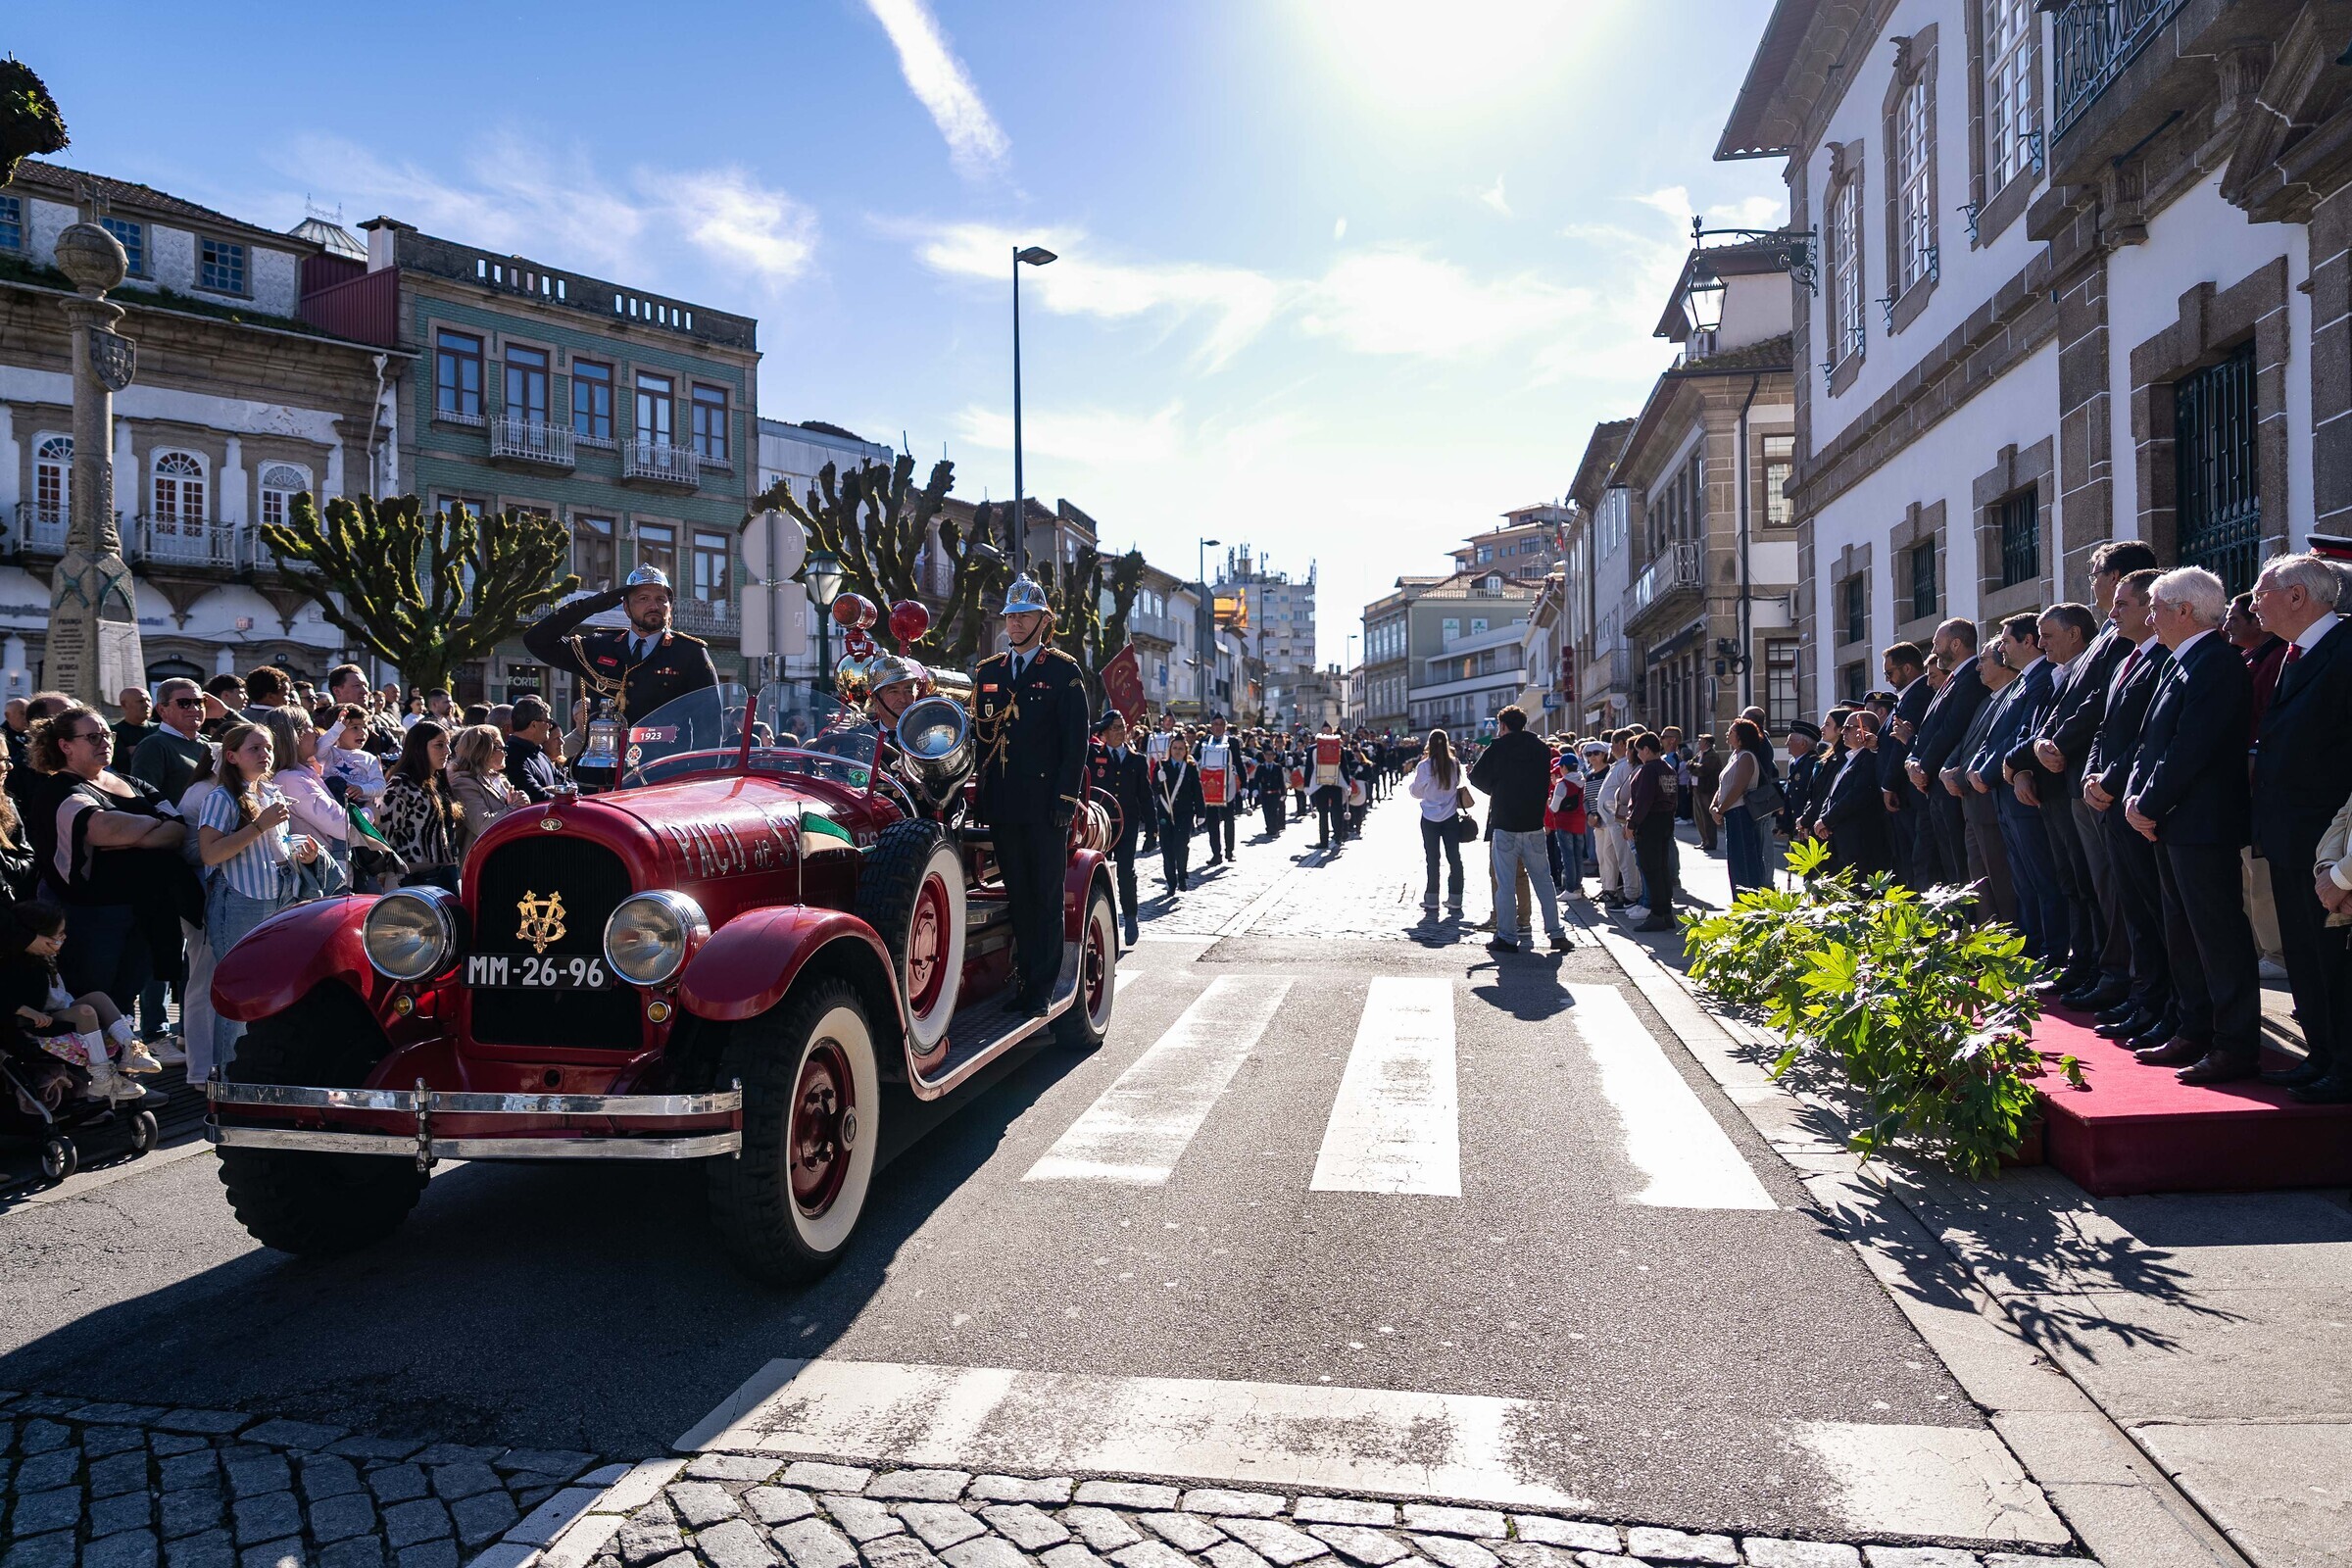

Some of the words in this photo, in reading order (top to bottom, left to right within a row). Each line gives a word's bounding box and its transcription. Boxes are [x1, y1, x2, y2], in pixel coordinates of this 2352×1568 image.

[508, 676, 539, 687] FORTE
[754, 839, 774, 868] de
[467, 956, 605, 988] MM-26-96
